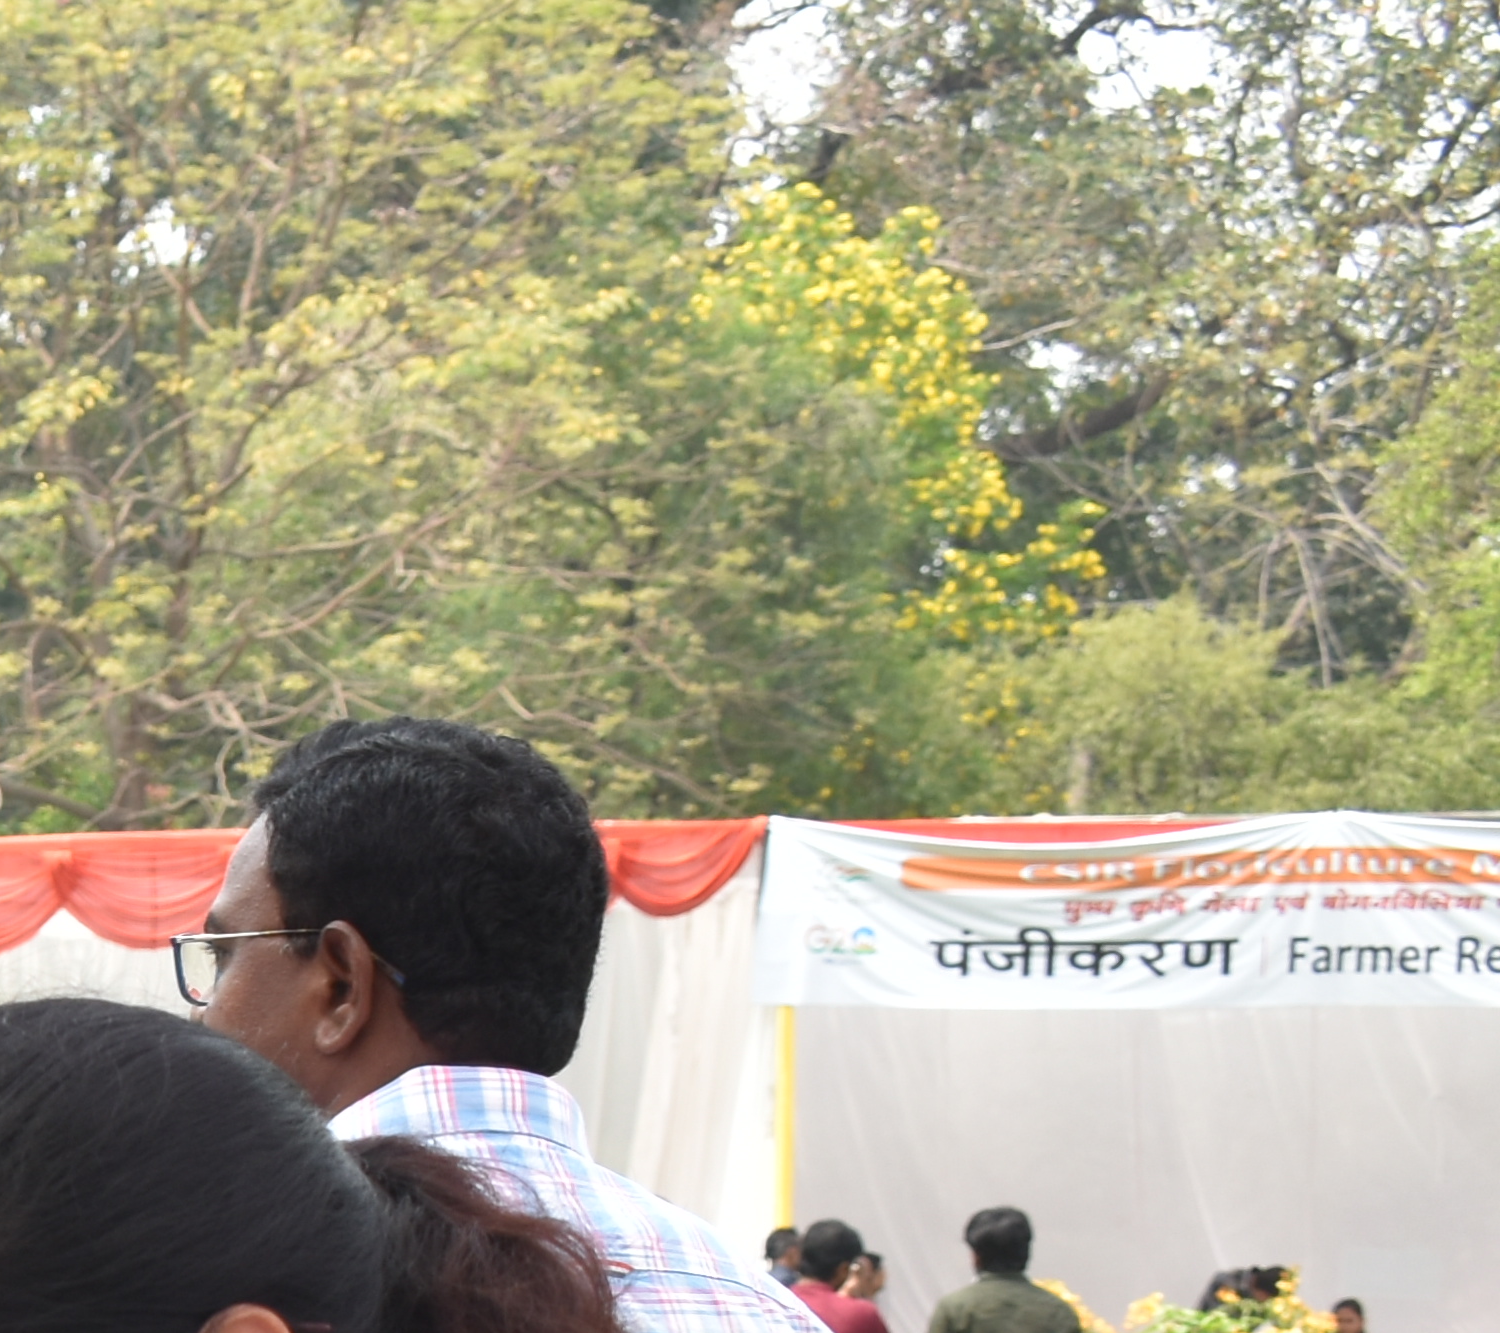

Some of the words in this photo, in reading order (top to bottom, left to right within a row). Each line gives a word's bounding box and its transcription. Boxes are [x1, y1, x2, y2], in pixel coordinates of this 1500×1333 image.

[1018, 860, 1138, 884] CSIR
[1152, 850, 1455, 882] Floriculture
[930, 926, 1238, 977] पंजीकरण
[1287, 936, 1442, 975] Farmer
